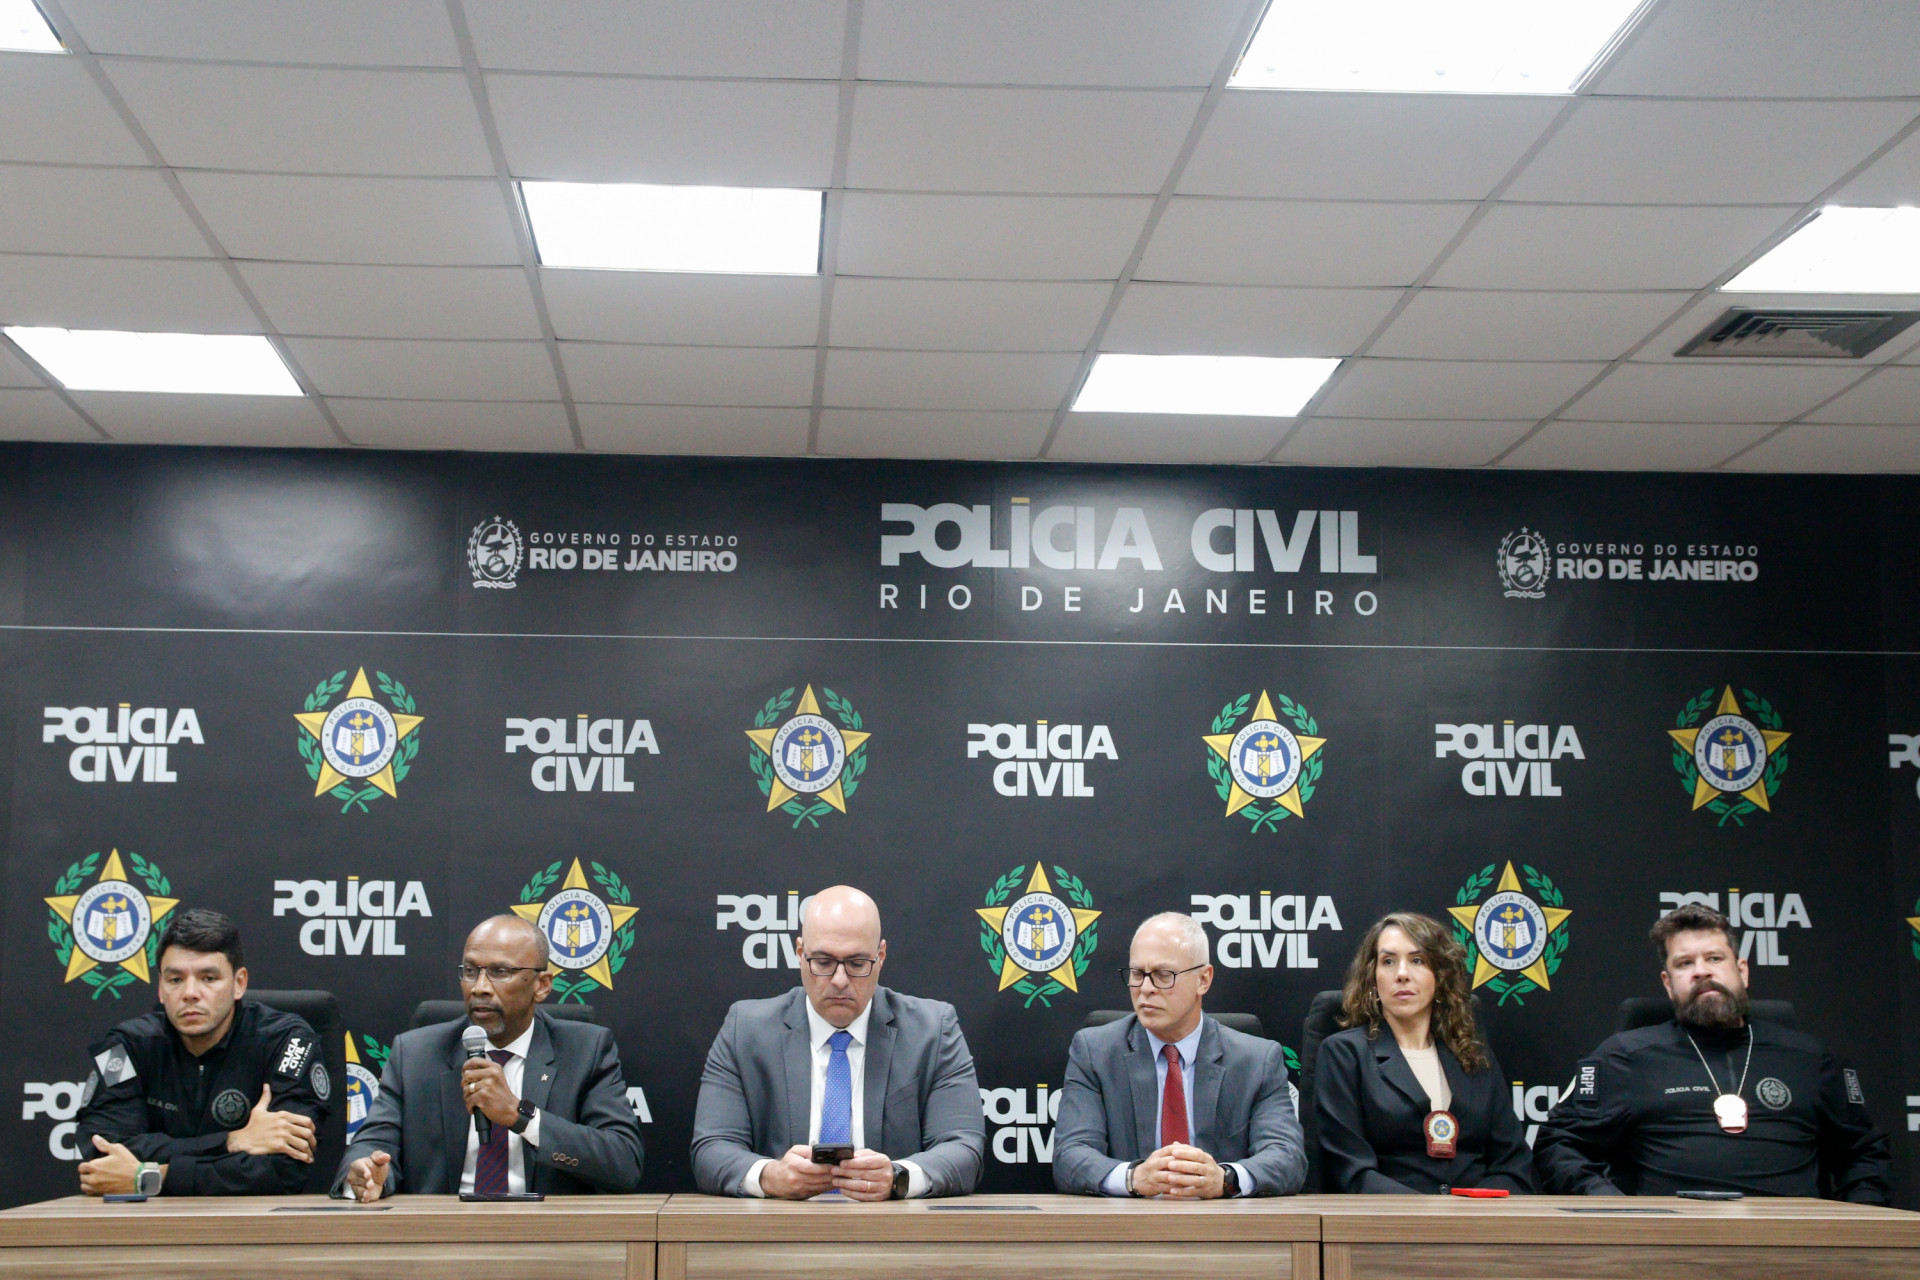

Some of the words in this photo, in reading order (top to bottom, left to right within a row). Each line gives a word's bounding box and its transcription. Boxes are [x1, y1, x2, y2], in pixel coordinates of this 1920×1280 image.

[530, 532, 621, 546] GOVERNO
[631, 534, 655, 546] DO
[665, 535, 738, 547] ESTADO
[880, 497, 1163, 571] POLÍCIA
[1191, 508, 1377, 573] CIVIL
[1556, 543, 1644, 555] GOVERNO
[1654, 545, 1678, 556] DO
[1687, 545, 1758, 557] ESTADO
[529, 548, 578, 570] RIO
[583, 549, 618, 571] DE
[624, 550, 738, 572] JANEIRO
[1557, 558, 1604, 580] RIO
[1609, 559, 1643, 580] DE
[1648, 560, 1759, 581] JANEIRO
[880, 584, 973, 610] RIO
[1020, 586, 1082, 612] DE
[1129, 588, 1378, 616] JANEIRO
[43, 703, 205, 745] POLÍCIA
[506, 713, 661, 755] POLÍCIA
[817, 720, 838, 741] CIVIL
[968, 719, 1120, 761] POLÍCIA
[1273, 727, 1294, 746] CIVIL
[1436, 719, 1586, 760] POLÍCIA
[69, 744, 178, 783] CIVIL
[531, 755, 635, 793] CIVIL
[993, 760, 1095, 797] CIVIL
[1462, 760, 1562, 797] CIVIL
[273, 876, 433, 918] POLÍCIA
[584, 894, 605, 916] CIVIL
[1048, 898, 1069, 919] CIVIL
[1518, 897, 1540, 918] CIVIL
[299, 918, 406, 956] CIVIL
[1217, 932, 1319, 969] CIVIL
[356, 1068, 377, 1090] CIVIL
[1580, 1066, 1596, 1095] DGPE
